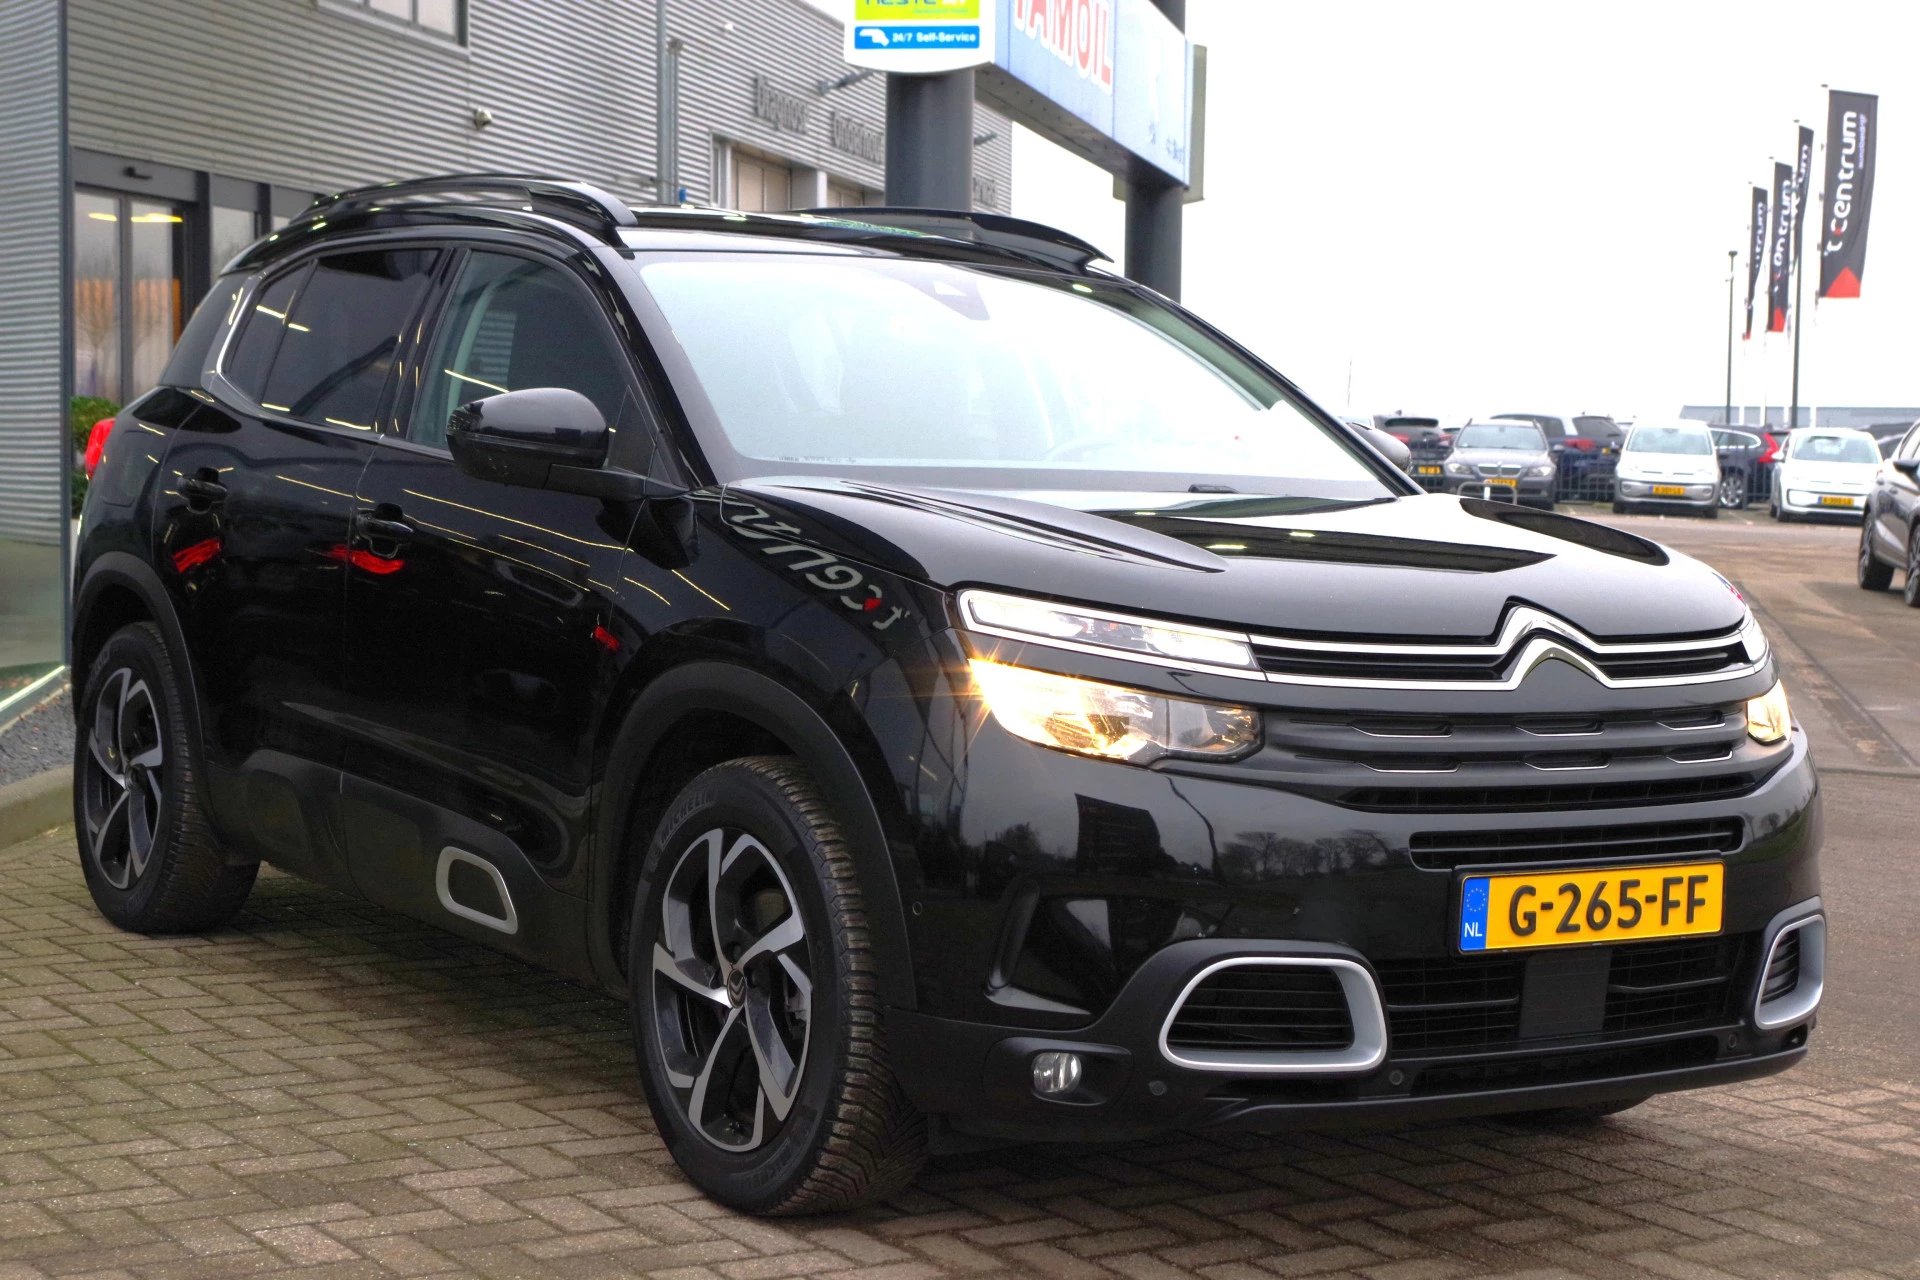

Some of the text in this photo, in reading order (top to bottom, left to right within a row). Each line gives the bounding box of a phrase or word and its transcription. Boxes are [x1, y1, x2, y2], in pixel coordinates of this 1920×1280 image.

[892, 31, 977, 43] 24/7 Self-Service
[1014, 0, 1112, 87] MOIL
[1829, 111, 1858, 236] centrum
[1464, 875, 1709, 938] NL G-265-FF
